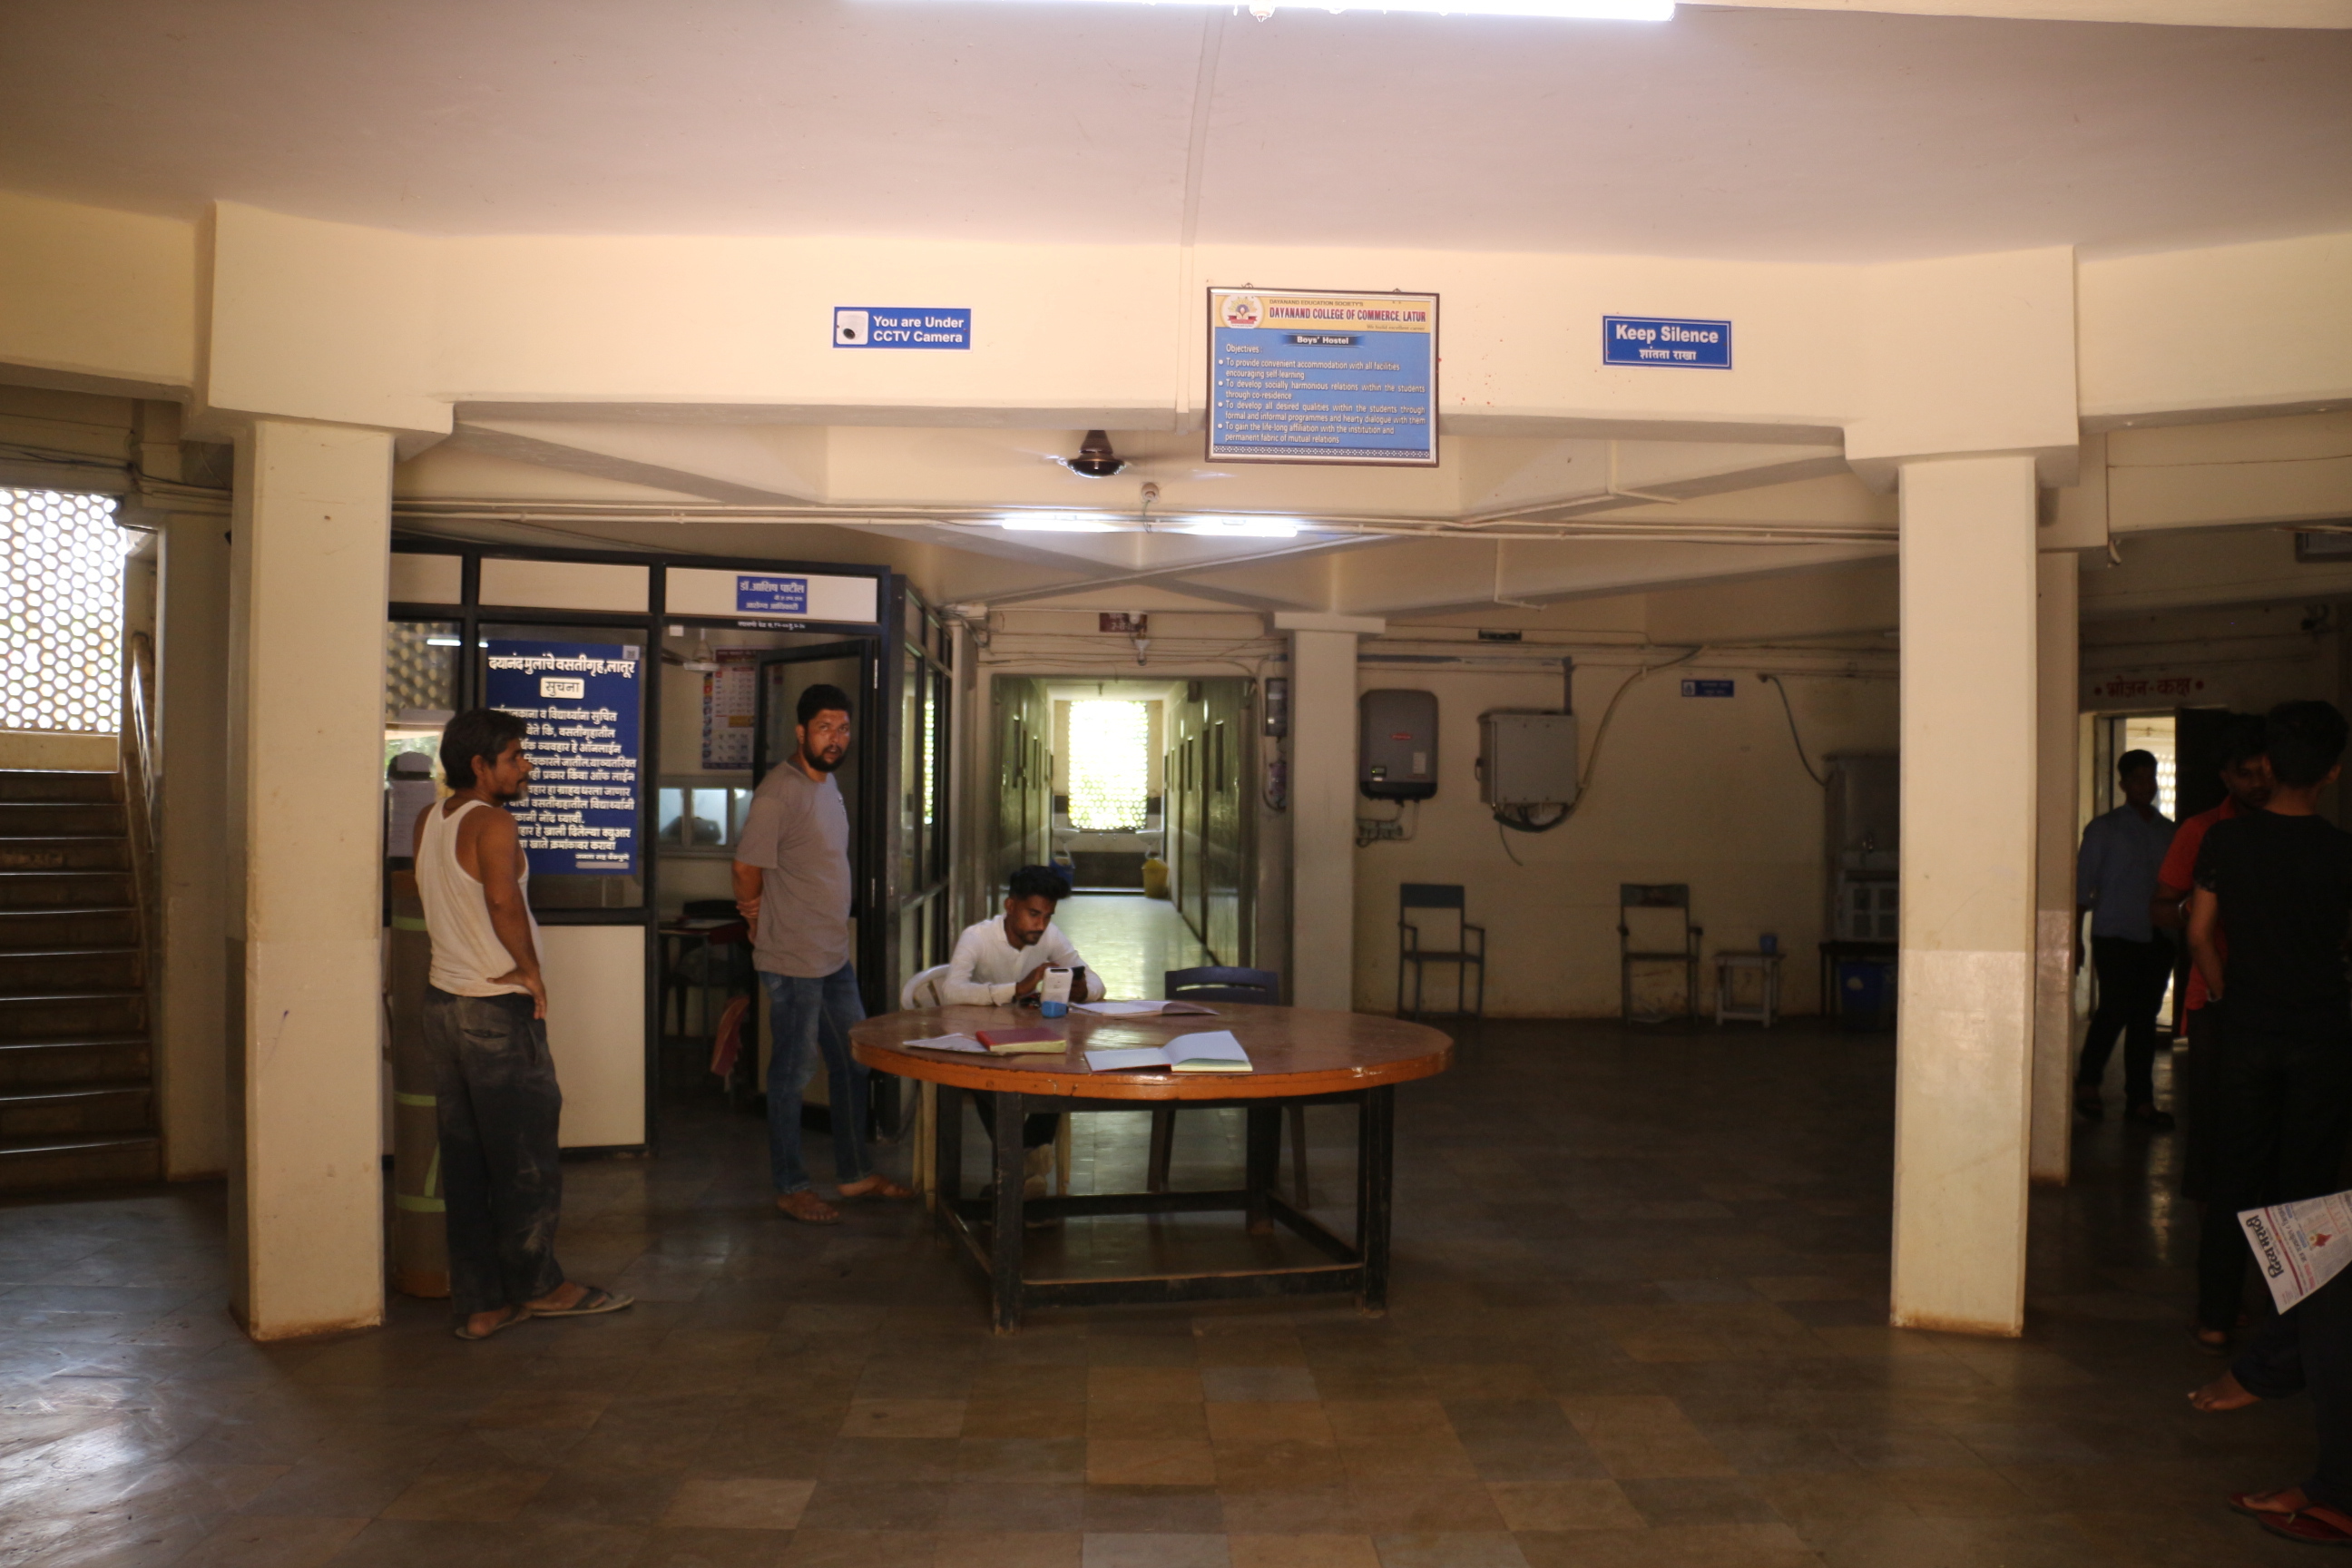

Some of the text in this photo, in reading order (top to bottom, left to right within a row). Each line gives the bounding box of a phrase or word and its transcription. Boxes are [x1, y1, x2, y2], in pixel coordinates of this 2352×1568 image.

[1269, 307, 1310, 318] DAYANAND
[1312, 308, 1344, 320] COLLEGE
[1347, 309, 1356, 320] OF
[1403, 310, 1426, 322] LATUR
[873, 316, 964, 328] You are Under
[873, 330, 963, 343] CCTV Camera
[1322, 337, 1349, 346] Hostel
[1616, 325, 1719, 344] Keep Silence
[1639, 346, 1697, 360] शांतता राखा
[1226, 358, 1234, 367] To
[1235, 358, 1259, 368] provide
[1260, 358, 1296, 368] convenient
[1297, 360, 1348, 370] accommodation
[1349, 361, 1363, 369] with
[1373, 362, 1399, 371] facilities
[1226, 369, 1305, 380] encouraging self-learning
[1226, 379, 1425, 393] To develop socially harmonious relations within the students
[1226, 390, 1292, 400] through co-residence
[1226, 400, 1425, 415] To develop all desired qualities within the students through
[1225, 411, 1426, 425] formal and informal programmes and hearty dialogue with them
[1225, 422, 1395, 435] To gain the life-long affiliation with the institution and
[1225, 433, 1340, 444] permanent fabric of mutual relations
[488, 652, 524, 671] दयानंद
[524, 653, 555, 674] मुलांचे
[544, 681, 581, 696] सुचना
[2246, 1215, 2270, 1248] मराठी
[2266, 1247, 2284, 1278] दिव्य
